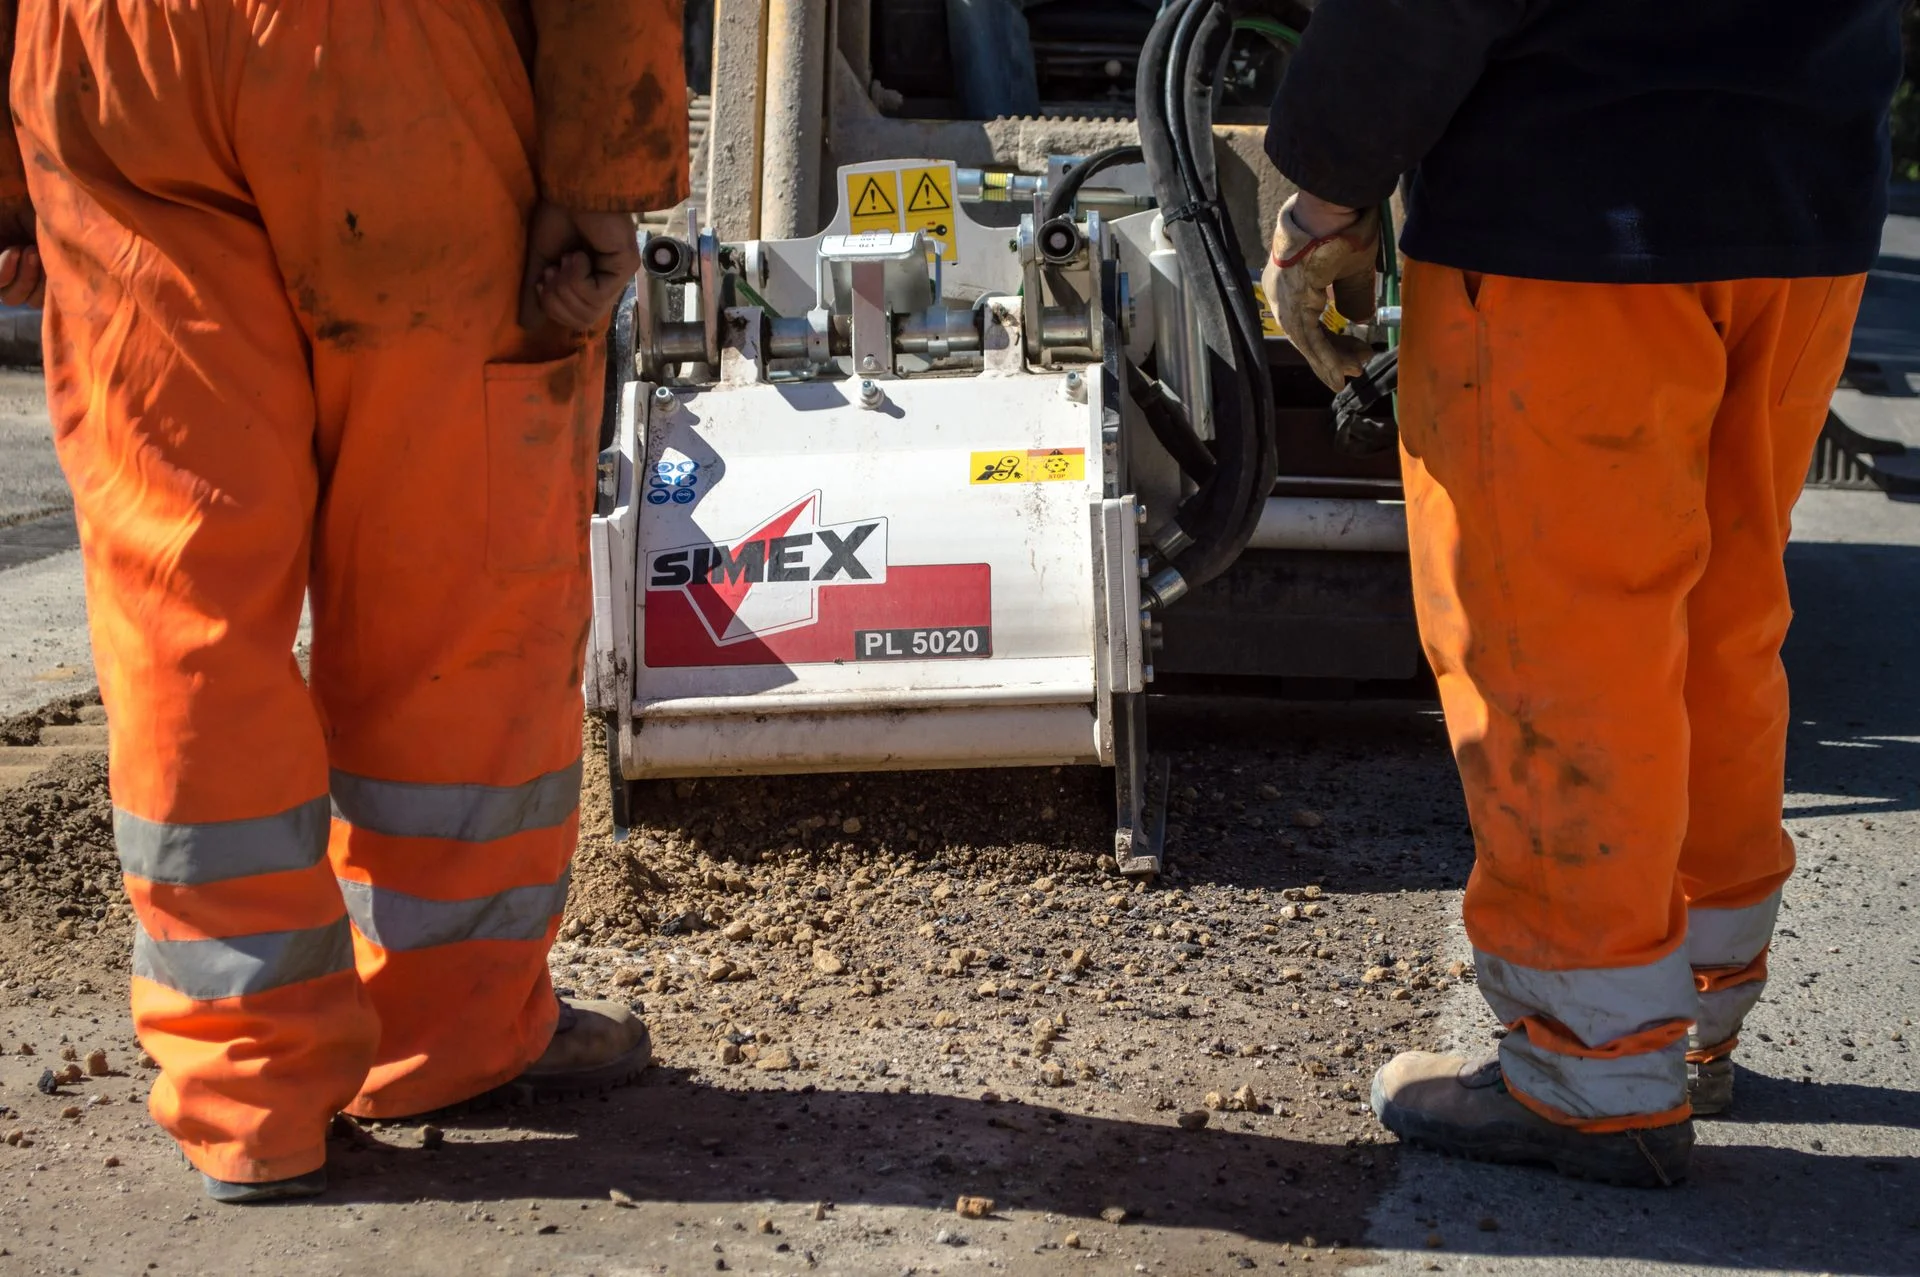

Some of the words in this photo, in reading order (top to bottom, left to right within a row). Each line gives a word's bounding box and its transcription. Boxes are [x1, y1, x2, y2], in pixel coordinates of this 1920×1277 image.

[651, 523, 880, 586] SIMEX
[865, 633, 902, 655] PL
[912, 630, 979, 655] 5020
